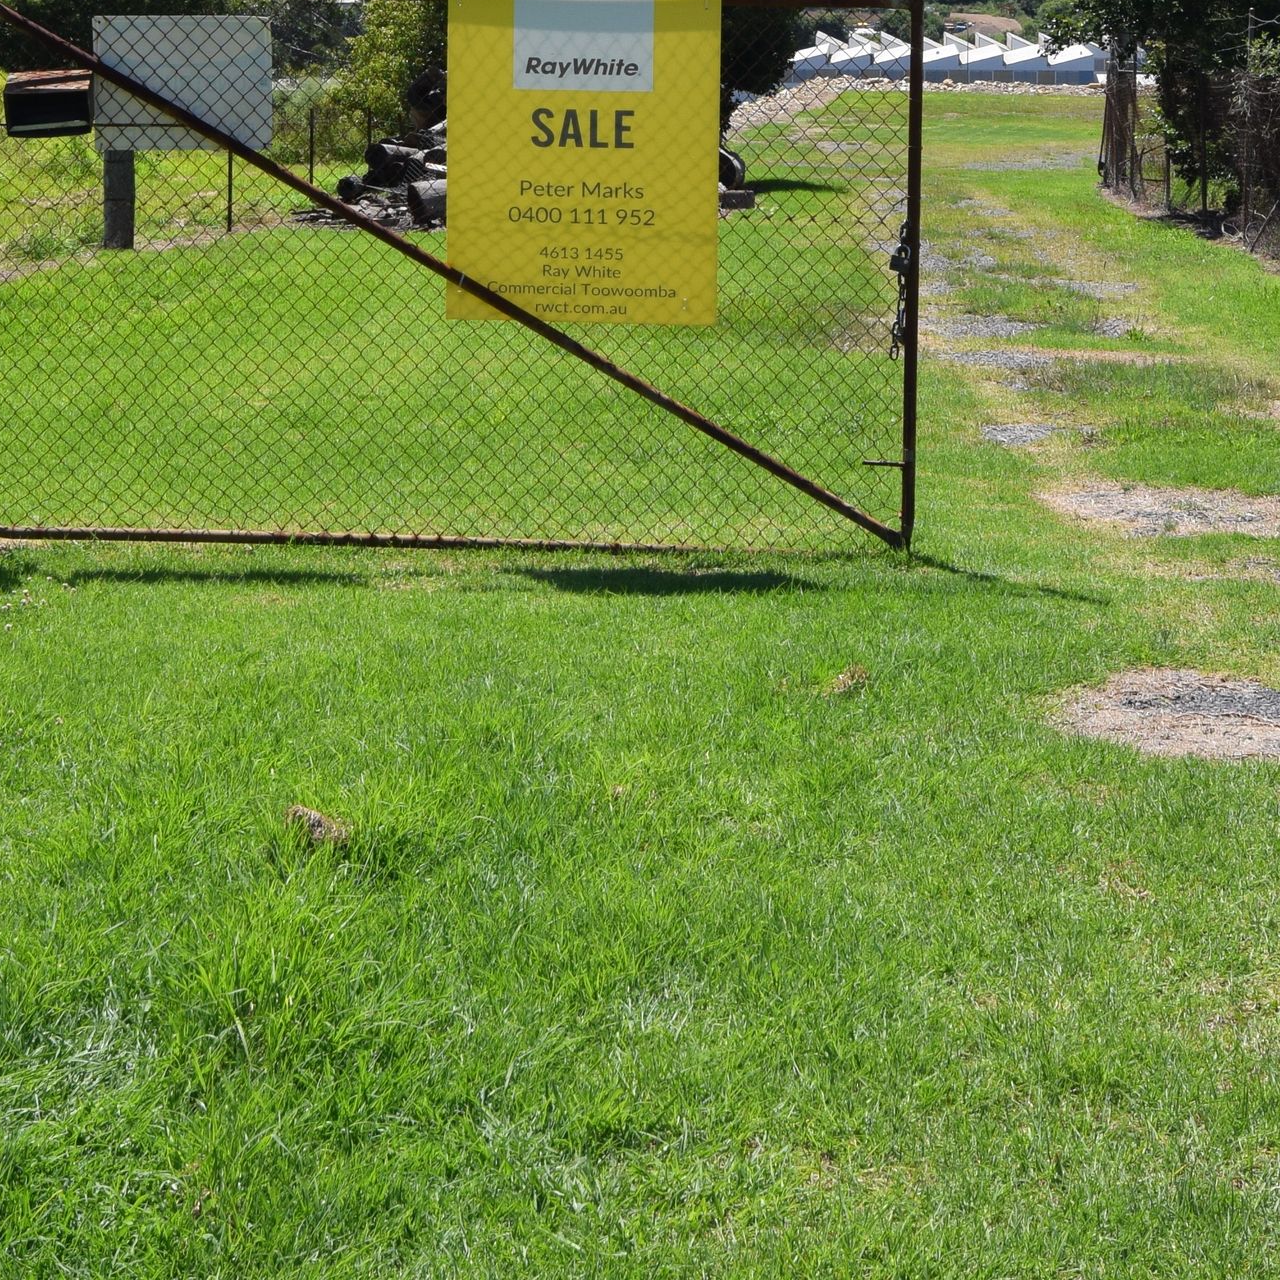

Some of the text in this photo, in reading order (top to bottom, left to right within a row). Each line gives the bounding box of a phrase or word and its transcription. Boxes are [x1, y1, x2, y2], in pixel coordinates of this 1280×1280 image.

[530, 107, 635, 148] SALE
[520, 180, 644, 199] Peter Marks
[508, 206, 655, 226] 0400 111 952
[539, 246, 624, 261] 4613 1455
[542, 264, 621, 279] Ray White
[487, 281, 677, 298] Commercial Toowoomba
[535, 302, 627, 316] rwct.com.au
